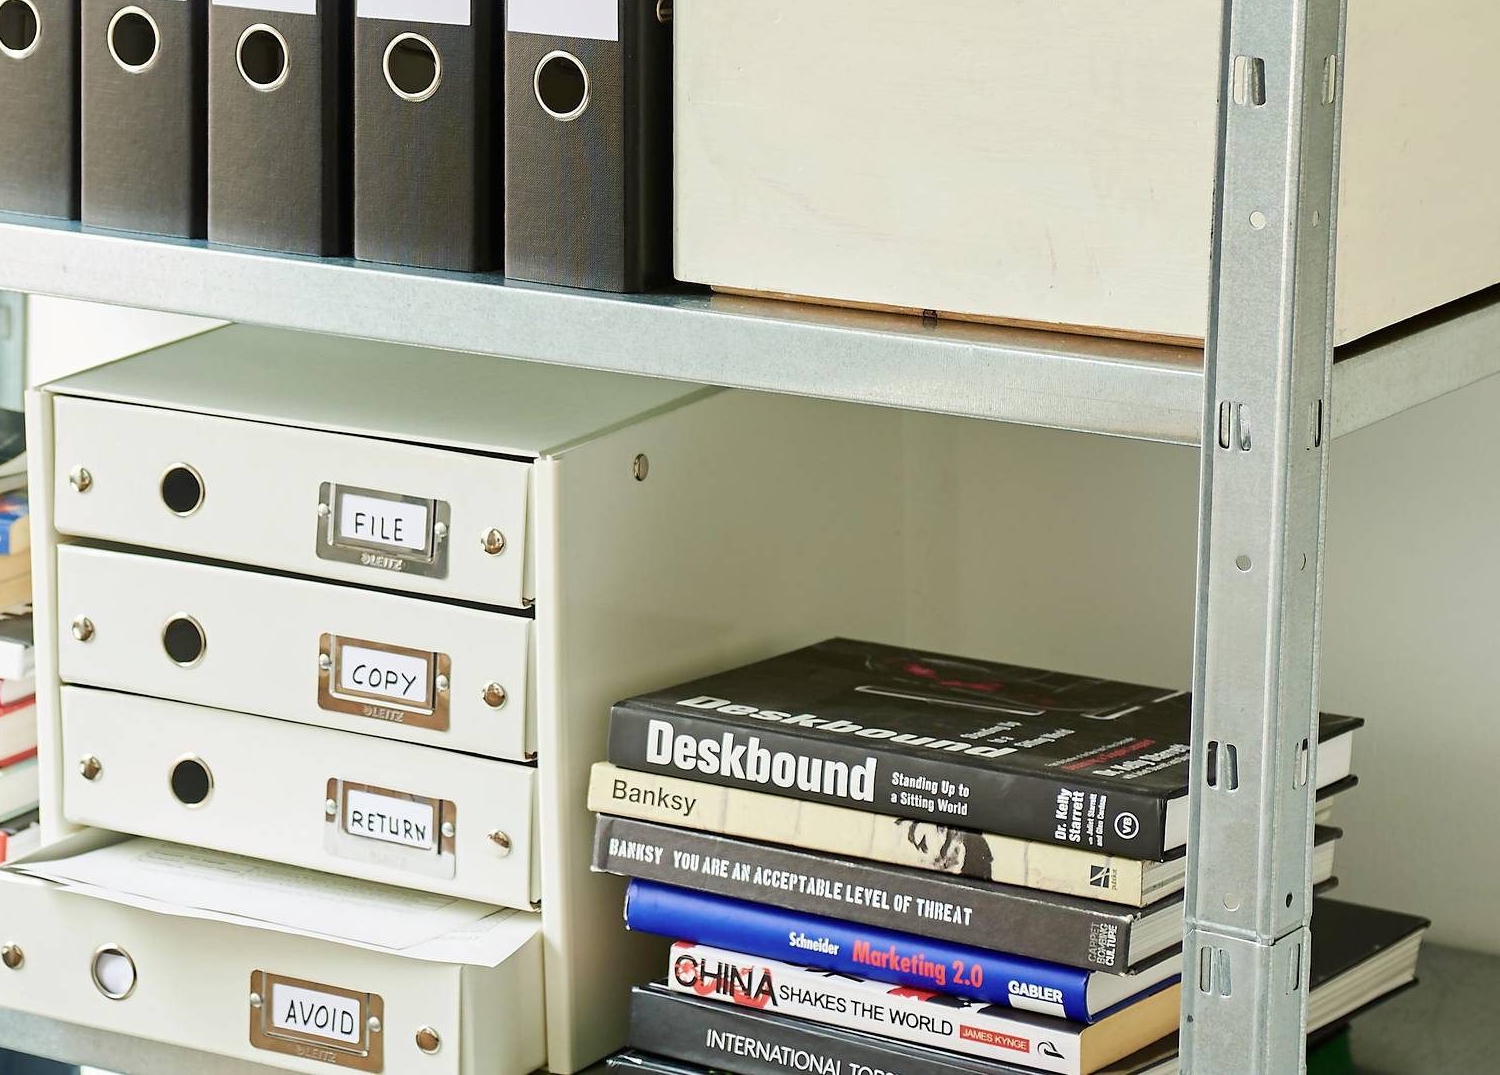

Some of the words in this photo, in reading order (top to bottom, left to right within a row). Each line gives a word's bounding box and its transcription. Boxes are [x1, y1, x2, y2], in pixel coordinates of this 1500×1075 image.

[355, 512, 404, 542] FILE
[369, 554, 404, 571] LEITZ
[352, 664, 417, 696] COPY
[371, 706, 404, 723] LEITZ
[675, 695, 1019, 759] Deskbound
[646, 718, 878, 803] Deskbound
[612, 779, 697, 817] Banksy
[891, 771, 939, 795] Standing
[941, 780, 956, 798] Up
[958, 783, 970, 798] to
[890, 792, 898, 803] a
[900, 791, 935, 813] Sitting
[937, 798, 968, 816] World
[1055, 787, 1073, 820] Kelly
[1068, 790, 1085, 843] Starrett
[352, 810, 426, 842] RETURN
[1054, 822, 1067, 841] Dr.
[1122, 816, 1133, 834] VB
[609, 837, 664, 865] BANKSY
[673, 850, 700, 872] YOU
[702, 856, 729, 878] ARE
[732, 862, 752, 882] AN
[753, 866, 843, 902] ACCEPTABLE
[845, 884, 890, 911] LEVEL
[893, 894, 913, 914] OF
[915, 898, 972, 926] THREAT
[788, 931, 840, 956] Schneider
[852, 939, 947, 987] Marketing
[952, 960, 983, 989] 2.0
[1105, 924, 1118, 967] CULTURE
[674, 955, 779, 1007] CHINA
[779, 985, 847, 1014] SHAKES
[850, 1000, 884, 1022] THE
[889, 1008, 954, 1037] WORLD
[1008, 980, 1064, 1004] GABLER
[285, 999, 354, 1035] AVOID
[963, 1028, 994, 1043] JAMES
[995, 1035, 1028, 1051] KYNGE
